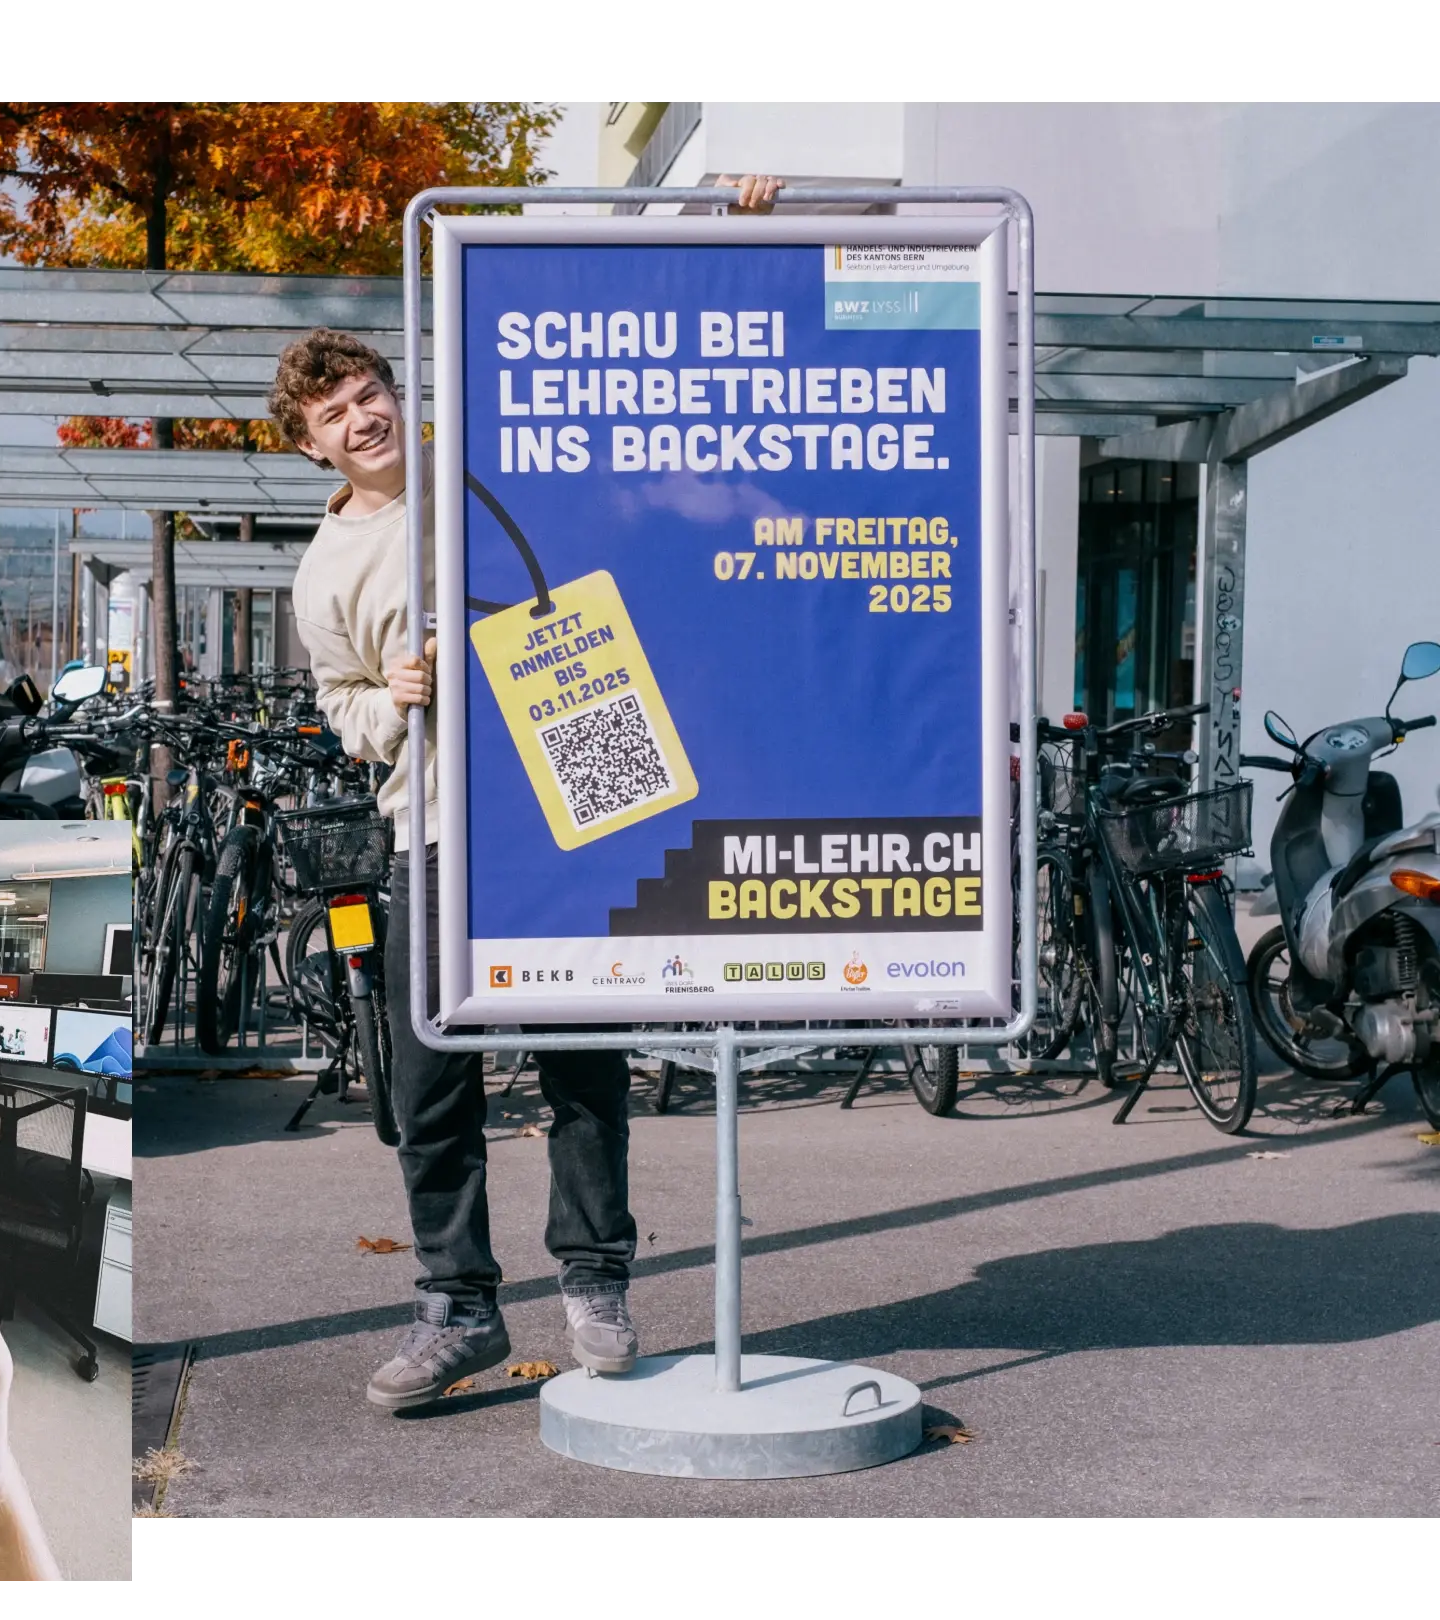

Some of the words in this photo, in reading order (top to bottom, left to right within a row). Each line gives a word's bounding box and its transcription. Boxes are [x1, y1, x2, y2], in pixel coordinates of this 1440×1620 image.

[907, 245, 977, 253] INDUSTRIEVEREIN
[834, 300, 870, 313] BWZ
[872, 300, 902, 314] LYSS
[496, 311, 678, 361] SCHAU
[700, 310, 784, 359] BEI
[499, 367, 946, 417] LEHRBETRIEBEN
[499, 425, 591, 474] INS
[612, 423, 951, 473] BACKSTAGE.
[753, 517, 803, 547] AM
[815, 516, 959, 551] FREITAG,
[713, 553, 765, 581] 07.
[776, 551, 952, 580] NOVEMBER
[868, 585, 953, 613] 2025
[523, 611, 584, 652] JETZT
[509, 625, 615, 682] ANMELDEN
[553, 662, 588, 688] BIS
[528, 668, 631, 723] 03.11.2025
[723, 831, 982, 875] MI-LEHR.CH
[708, 878, 982, 920] BACKSTAGE
[522, 969, 574, 982] BEKB
[592, 976, 646, 985] CENTRAVO
[727, 964, 823, 979] TALUS
[886, 960, 966, 978] evolon
[665, 986, 715, 994] FRIENISBERG
